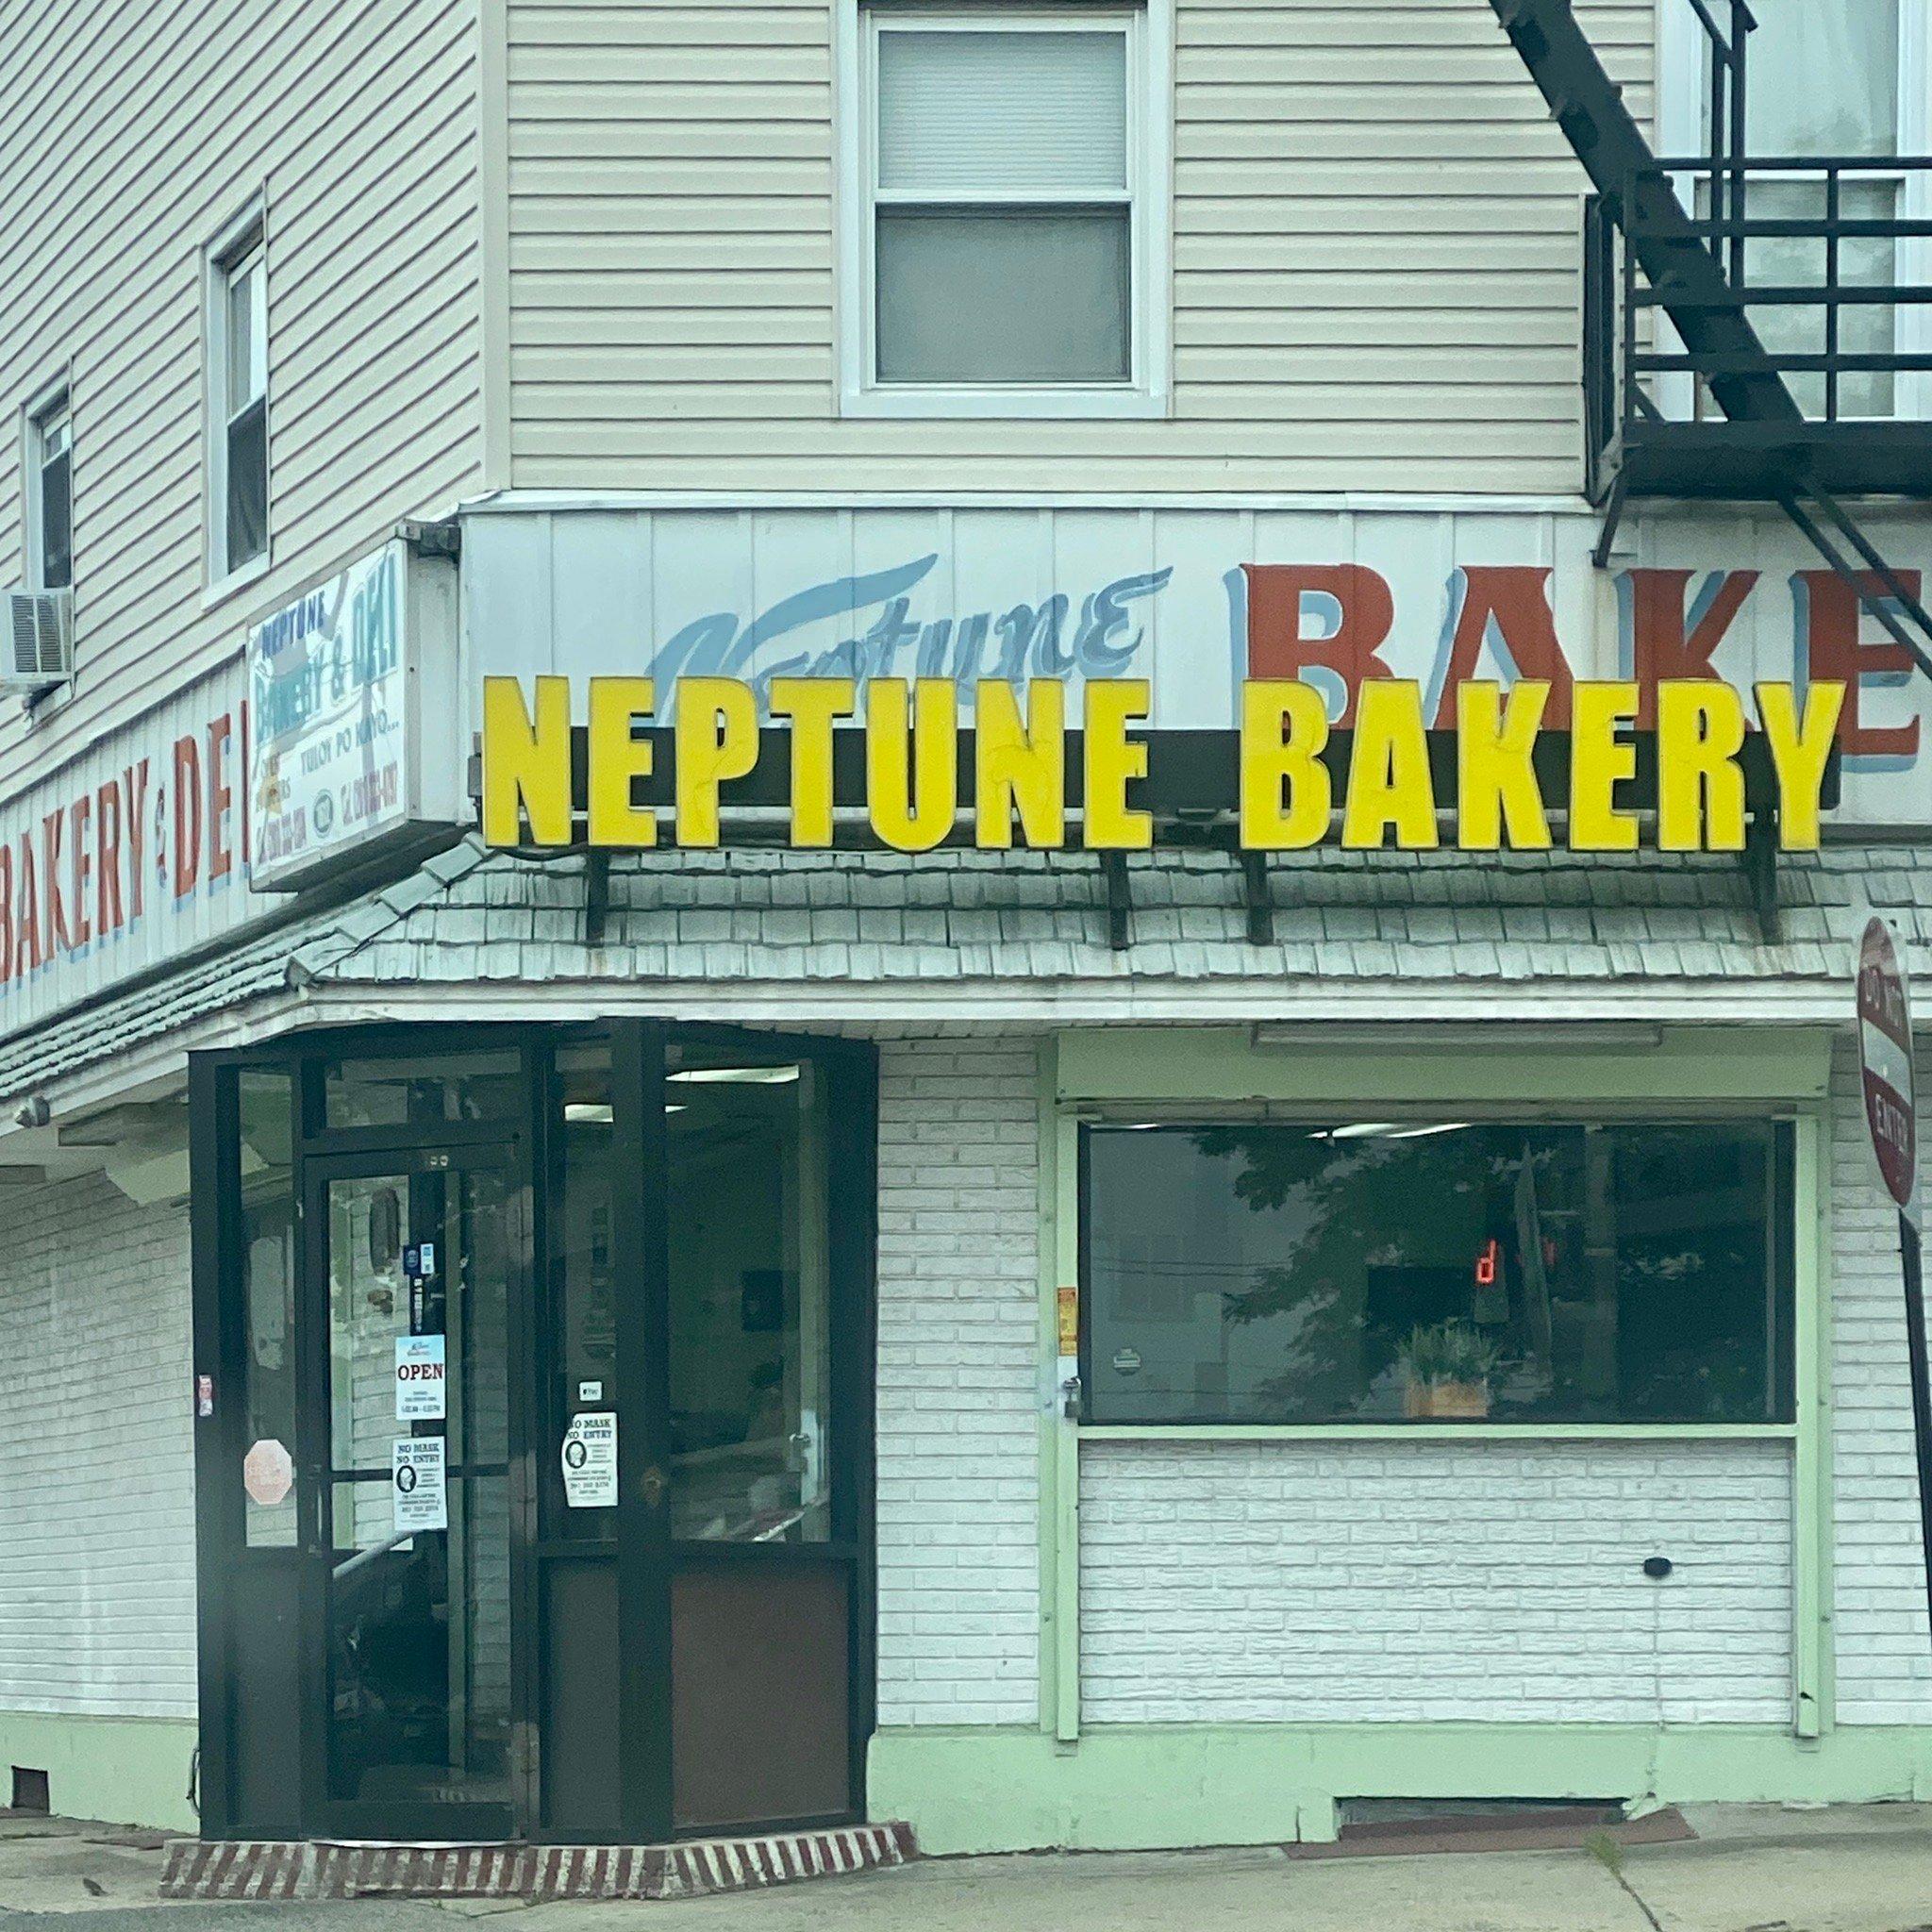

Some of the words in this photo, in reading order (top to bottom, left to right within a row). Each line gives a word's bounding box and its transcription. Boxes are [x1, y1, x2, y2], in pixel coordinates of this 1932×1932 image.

[262, 589, 326, 660] NEPTUNE
[482, 675, 1153, 852] NEPTUNE
[1239, 678, 1847, 852] BAKERY
[0, 758, 149, 985] BAKERY
[398, 1364, 444, 1381] OPEN
[584, 1419, 611, 1428] MASK
[583, 1430, 612, 1440] ENTRY
[398, 1444, 411, 1454] NO
[413, 1442, 440, 1453] MASK
[396, 1455, 410, 1464] NO
[413, 1454, 440, 1464] ENTRY
